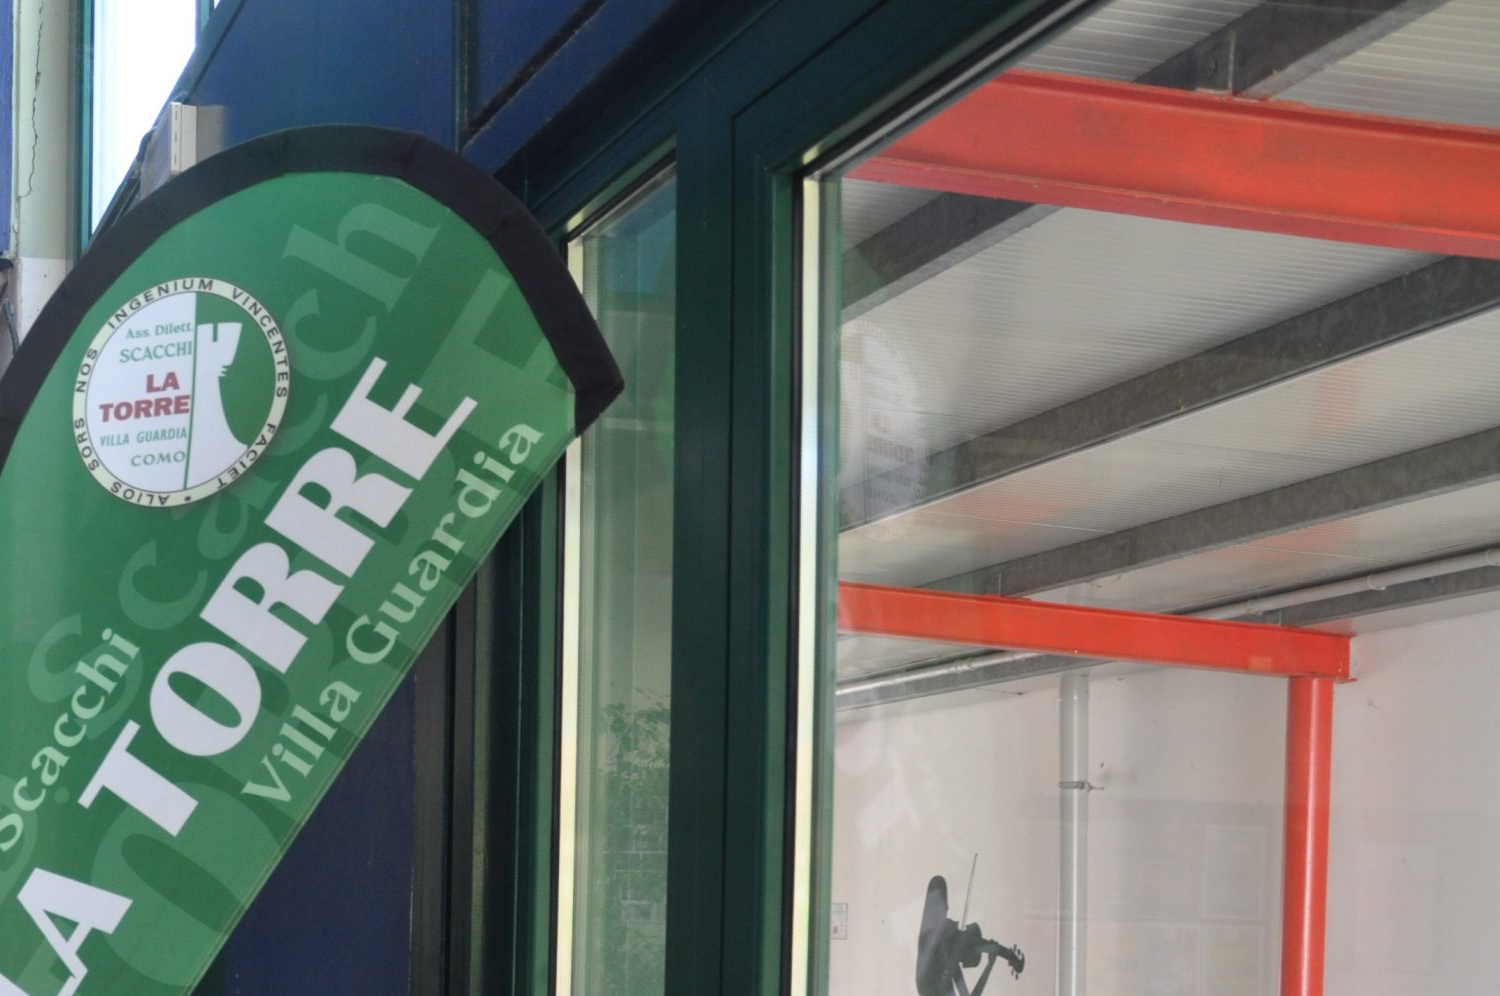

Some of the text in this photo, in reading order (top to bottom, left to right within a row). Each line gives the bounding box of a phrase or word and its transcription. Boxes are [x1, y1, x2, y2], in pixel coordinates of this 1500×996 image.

[119, 341, 193, 363] SCACCHI
[74, 278, 288, 506] ALIOS SORS NOS INGENIUM VINCENTES FACIET
[146, 372, 180, 393] LA
[99, 395, 190, 422] TORRE
[100, 427, 187, 447] VILLA GUARDIA
[131, 451, 186, 467] COMO
[77, 356, 479, 838] TORRE
[241, 423, 545, 806] Villa Guardia
